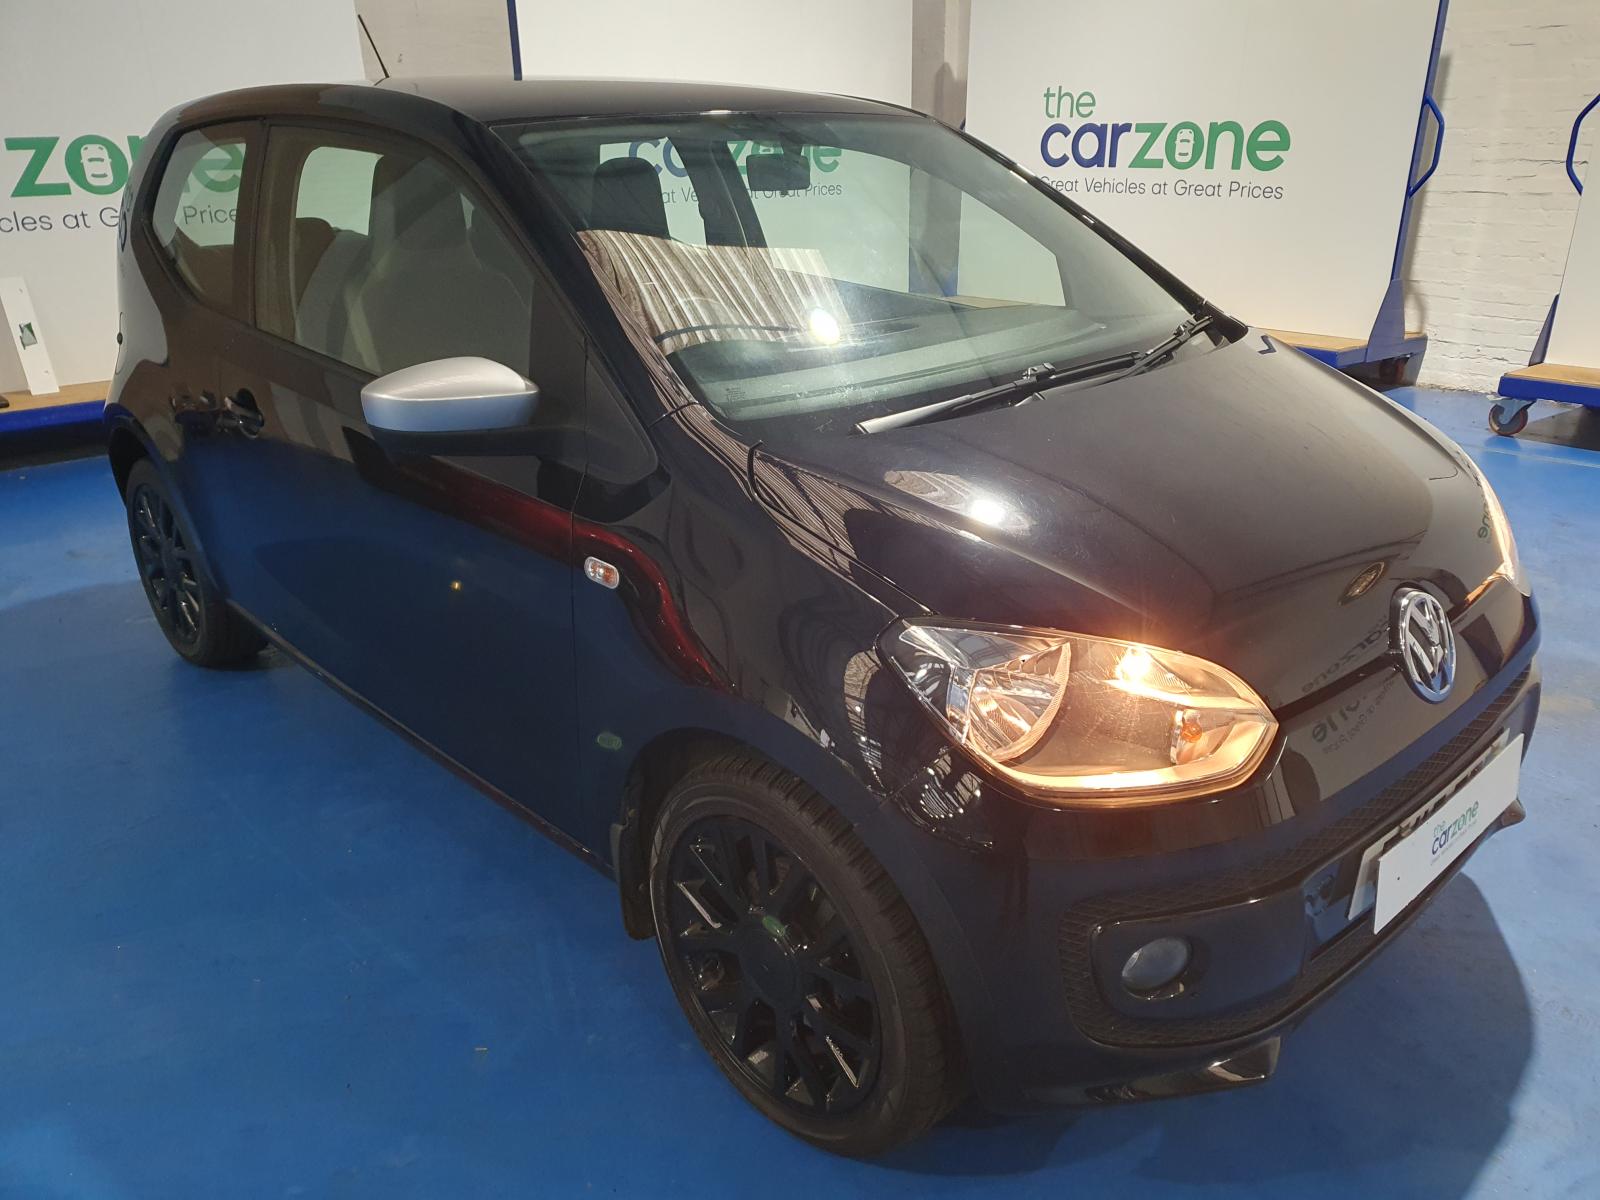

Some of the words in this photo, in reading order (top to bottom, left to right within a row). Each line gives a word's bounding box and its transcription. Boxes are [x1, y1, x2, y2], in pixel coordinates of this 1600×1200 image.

[1043, 85, 1096, 118] the
[1040, 120, 1291, 172] carzone
[1084, 177, 1146, 195] Vehicles
[1151, 180, 1168, 196] at
[1174, 179, 1222, 198] Great
[1229, 181, 1284, 200] Prices
[62, 210, 91, 229] at
[183, 204, 238, 224] Price
[1431, 800, 1479, 855] carzone
